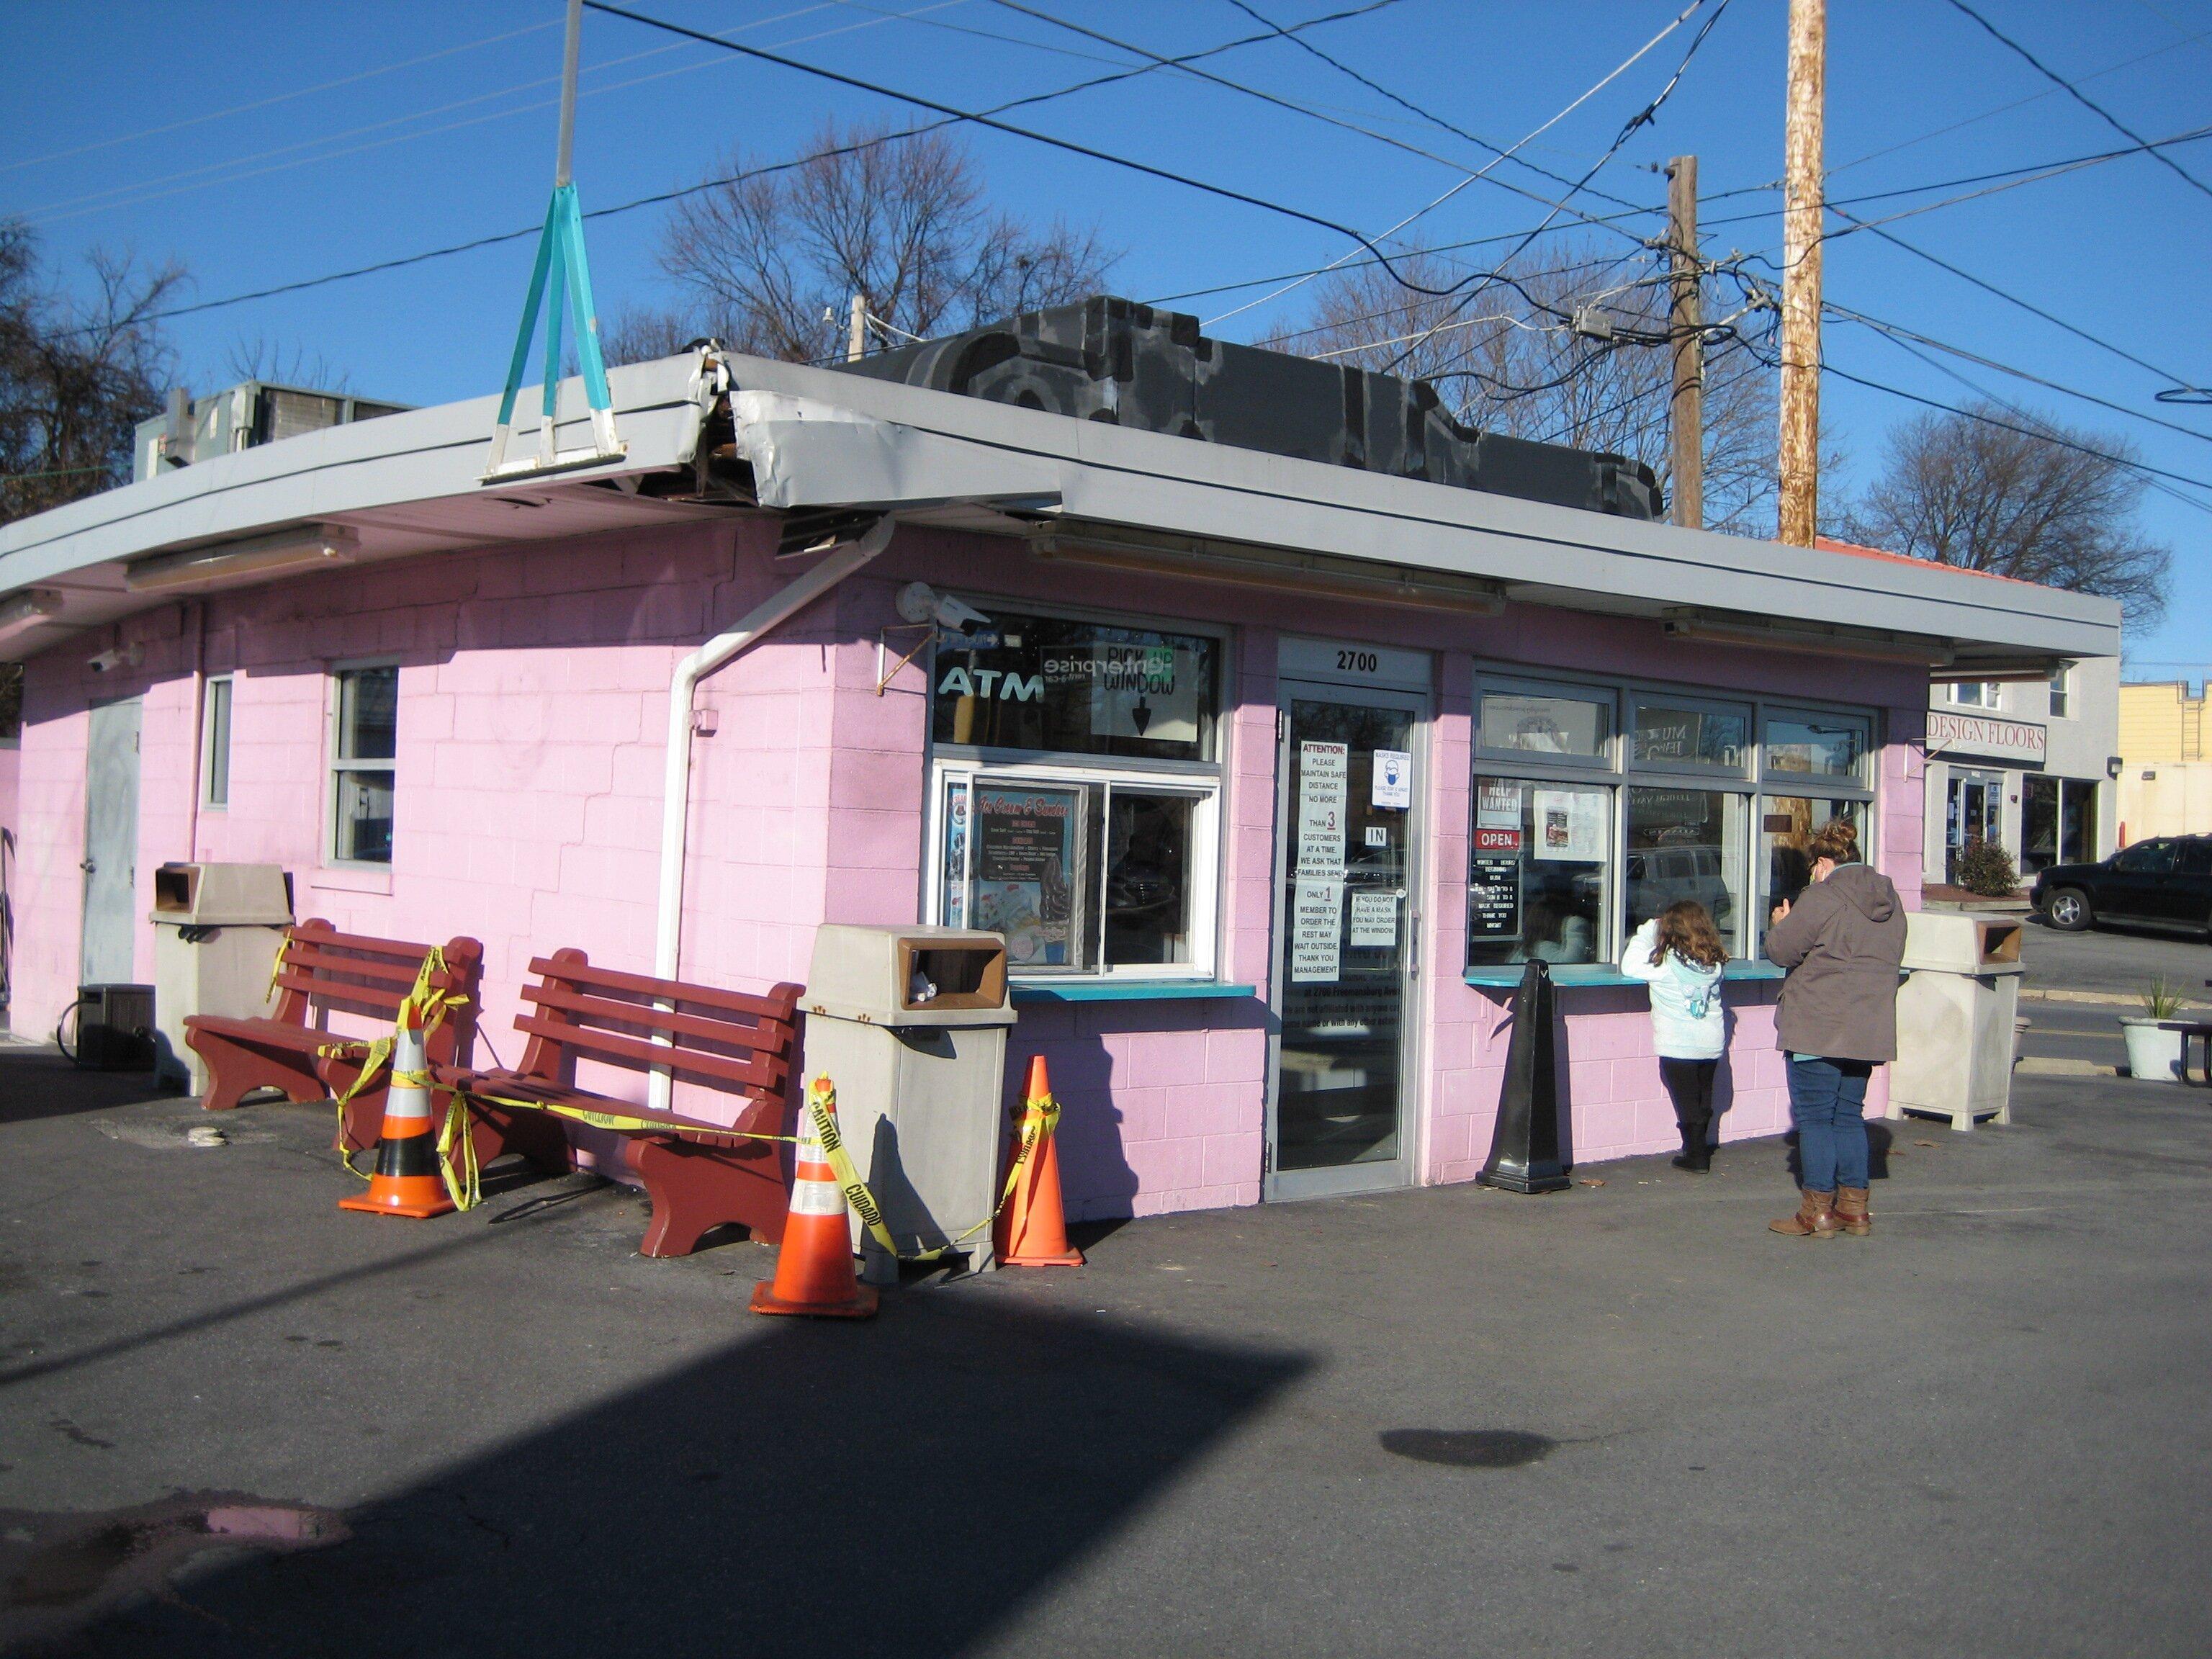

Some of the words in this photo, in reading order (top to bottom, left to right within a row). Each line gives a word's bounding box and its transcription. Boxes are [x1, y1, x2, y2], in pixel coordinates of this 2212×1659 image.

[1337, 650, 1377, 672] 2700
[938, 667, 1044, 703] ATM
[1104, 670, 1175, 696] WINDOW
[1928, 714, 1983, 742] DESIGN
[1988, 722, 2044, 750] FLOORS
[1303, 744, 1345, 755] ATTENTION:
[1301, 769, 1329, 778] MAINTAIN
[1482, 796, 1517, 811] WANTED
[1327, 811, 1336, 827] 3
[1370, 828, 1384, 842] IN
[1481, 833, 1512, 846] OPEN
[811, 1101, 842, 1153] CAUTION
[845, 1183, 882, 1226] CUIDADO
